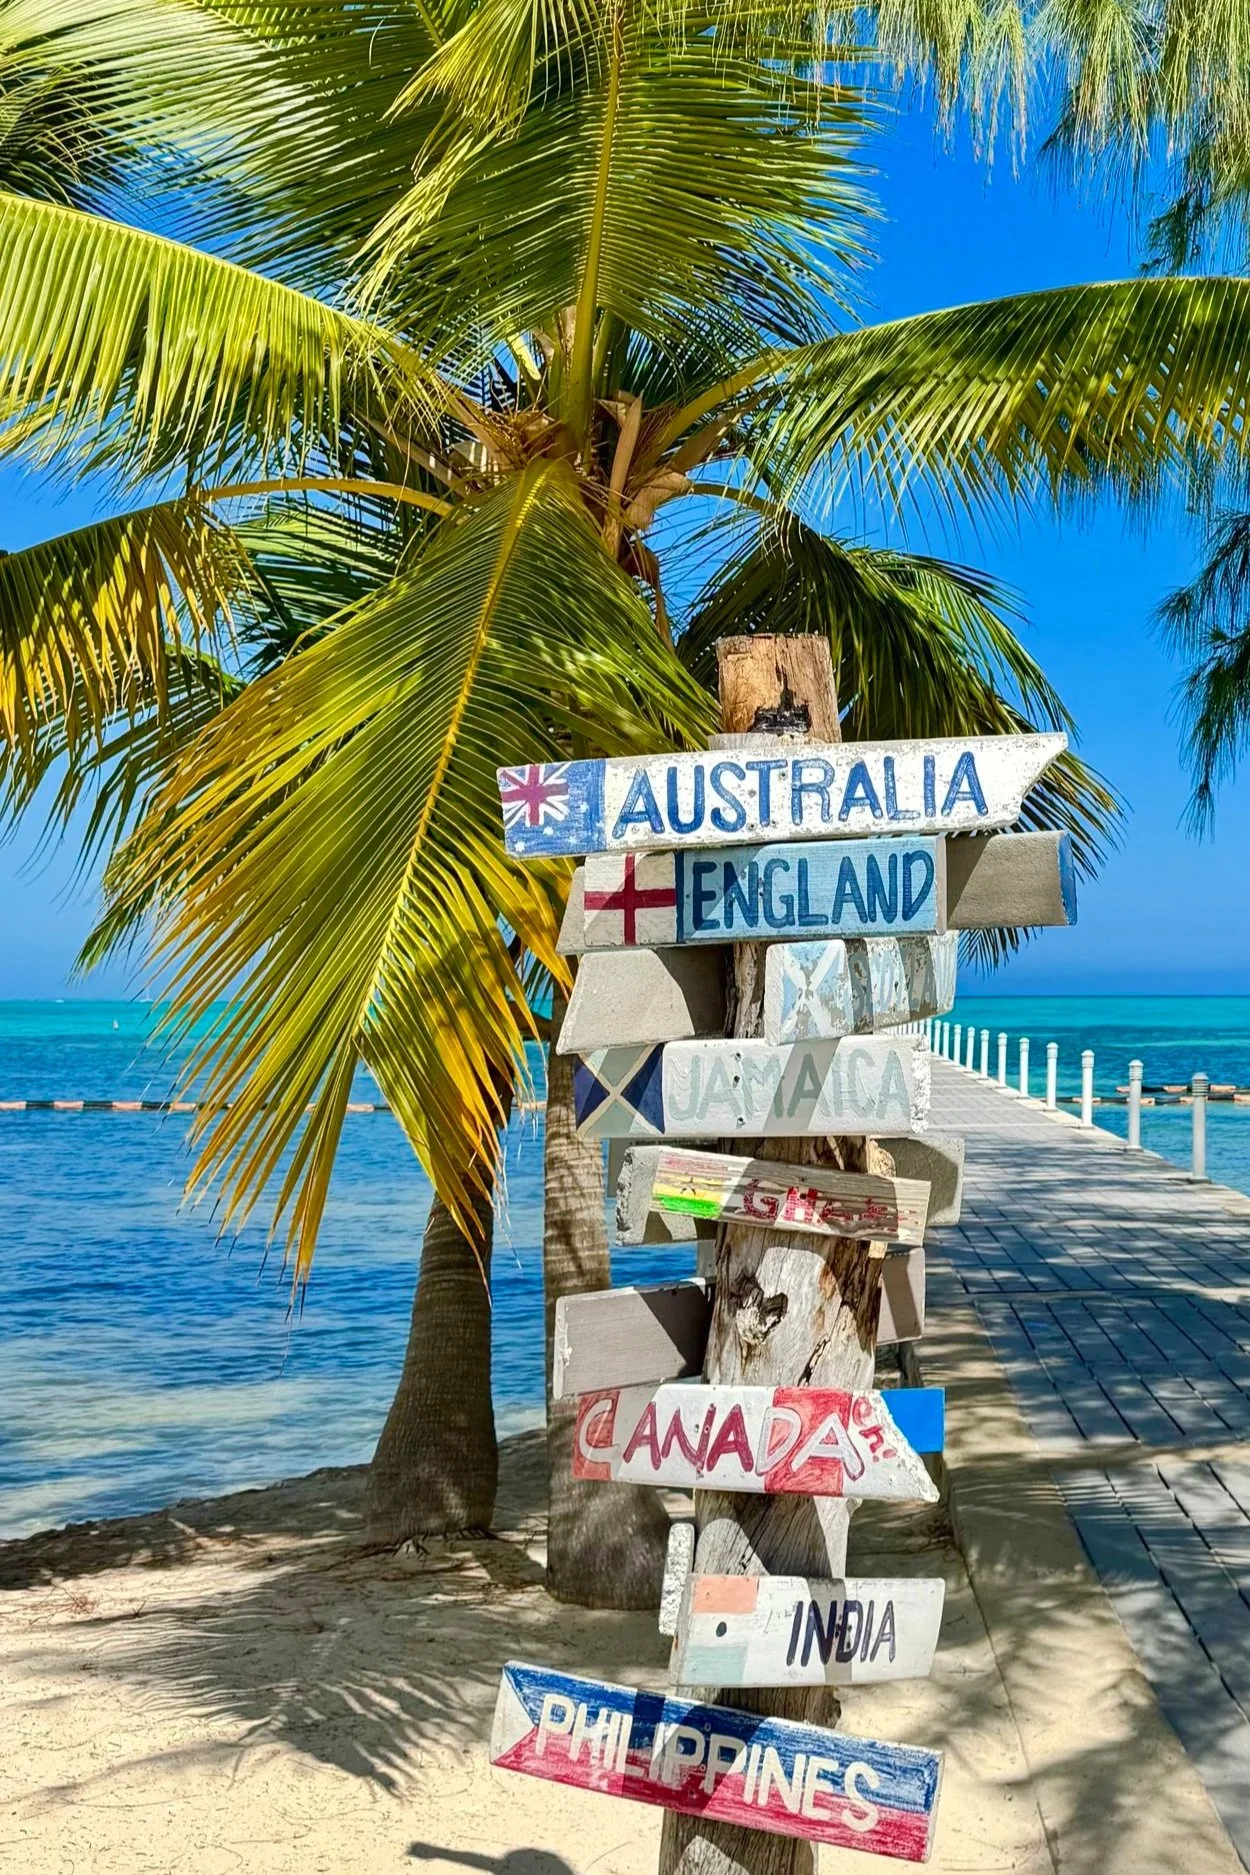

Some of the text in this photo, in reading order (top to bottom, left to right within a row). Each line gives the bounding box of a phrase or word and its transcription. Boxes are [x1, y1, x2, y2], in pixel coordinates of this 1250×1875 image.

[611, 750, 990, 840] AUSTRALIA
[691, 849, 935, 932] ENGLAND
[667, 1049, 911, 1122] JAMAICA
[578, 1398, 866, 1482] CANADA
[786, 1599, 896, 1667] INDIA
[534, 1693, 880, 1834] PHILIPPINES
